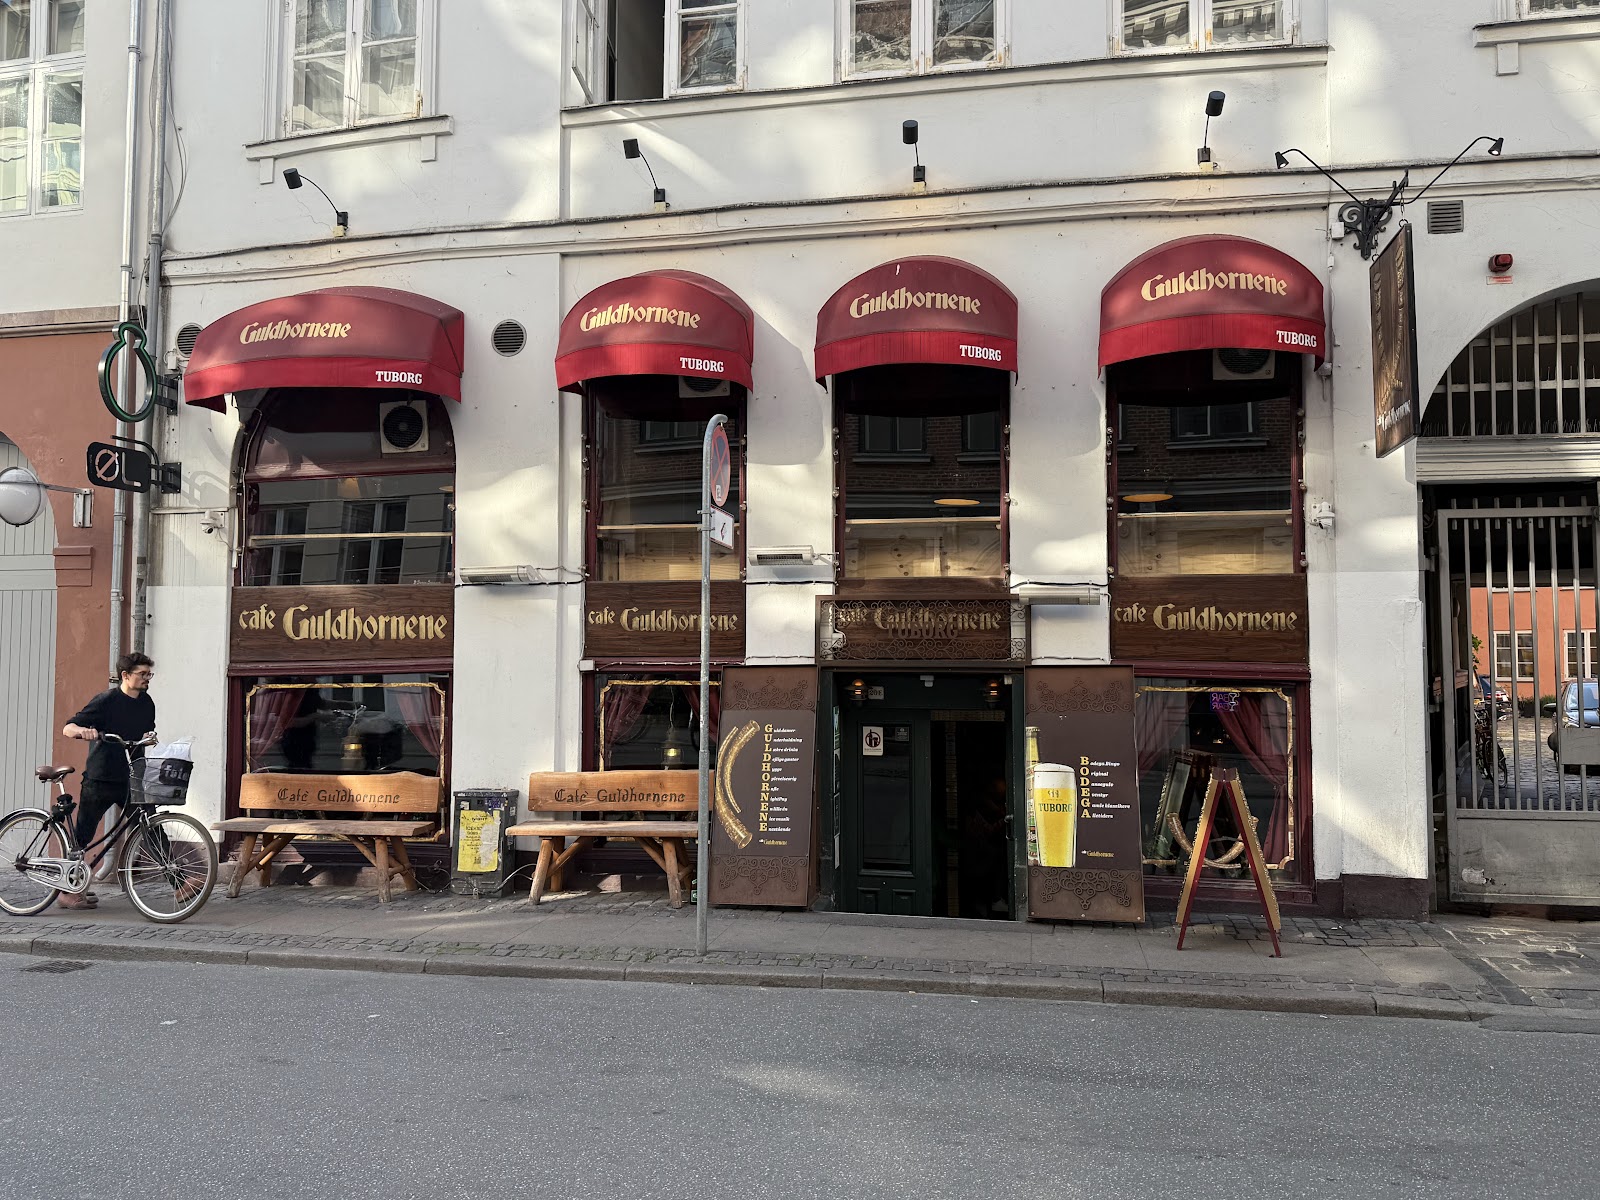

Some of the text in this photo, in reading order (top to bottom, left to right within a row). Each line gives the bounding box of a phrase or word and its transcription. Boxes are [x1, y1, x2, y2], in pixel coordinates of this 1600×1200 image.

[1140, 267, 1288, 302] Guldhornene
[849, 286, 981, 319] Guldhornene
[579, 301, 701, 332] Guldhornene
[239, 318, 353, 345] Guldhornene
[1276, 330, 1318, 348] TUBORG
[959, 344, 1002, 362] TUBORG
[679, 357, 725, 373] TUBORG
[375, 370, 423, 385] TUBORG
[238, 603, 449, 642] cafe Guldhornene
[588, 606, 616, 625] cafe
[1114, 602, 1298, 632] cafe Guldhornene
[317, 788, 401, 804] Guldhornene
[596, 787, 686, 803] Guldhornene
[1038, 803, 1073, 813] TUBORG
